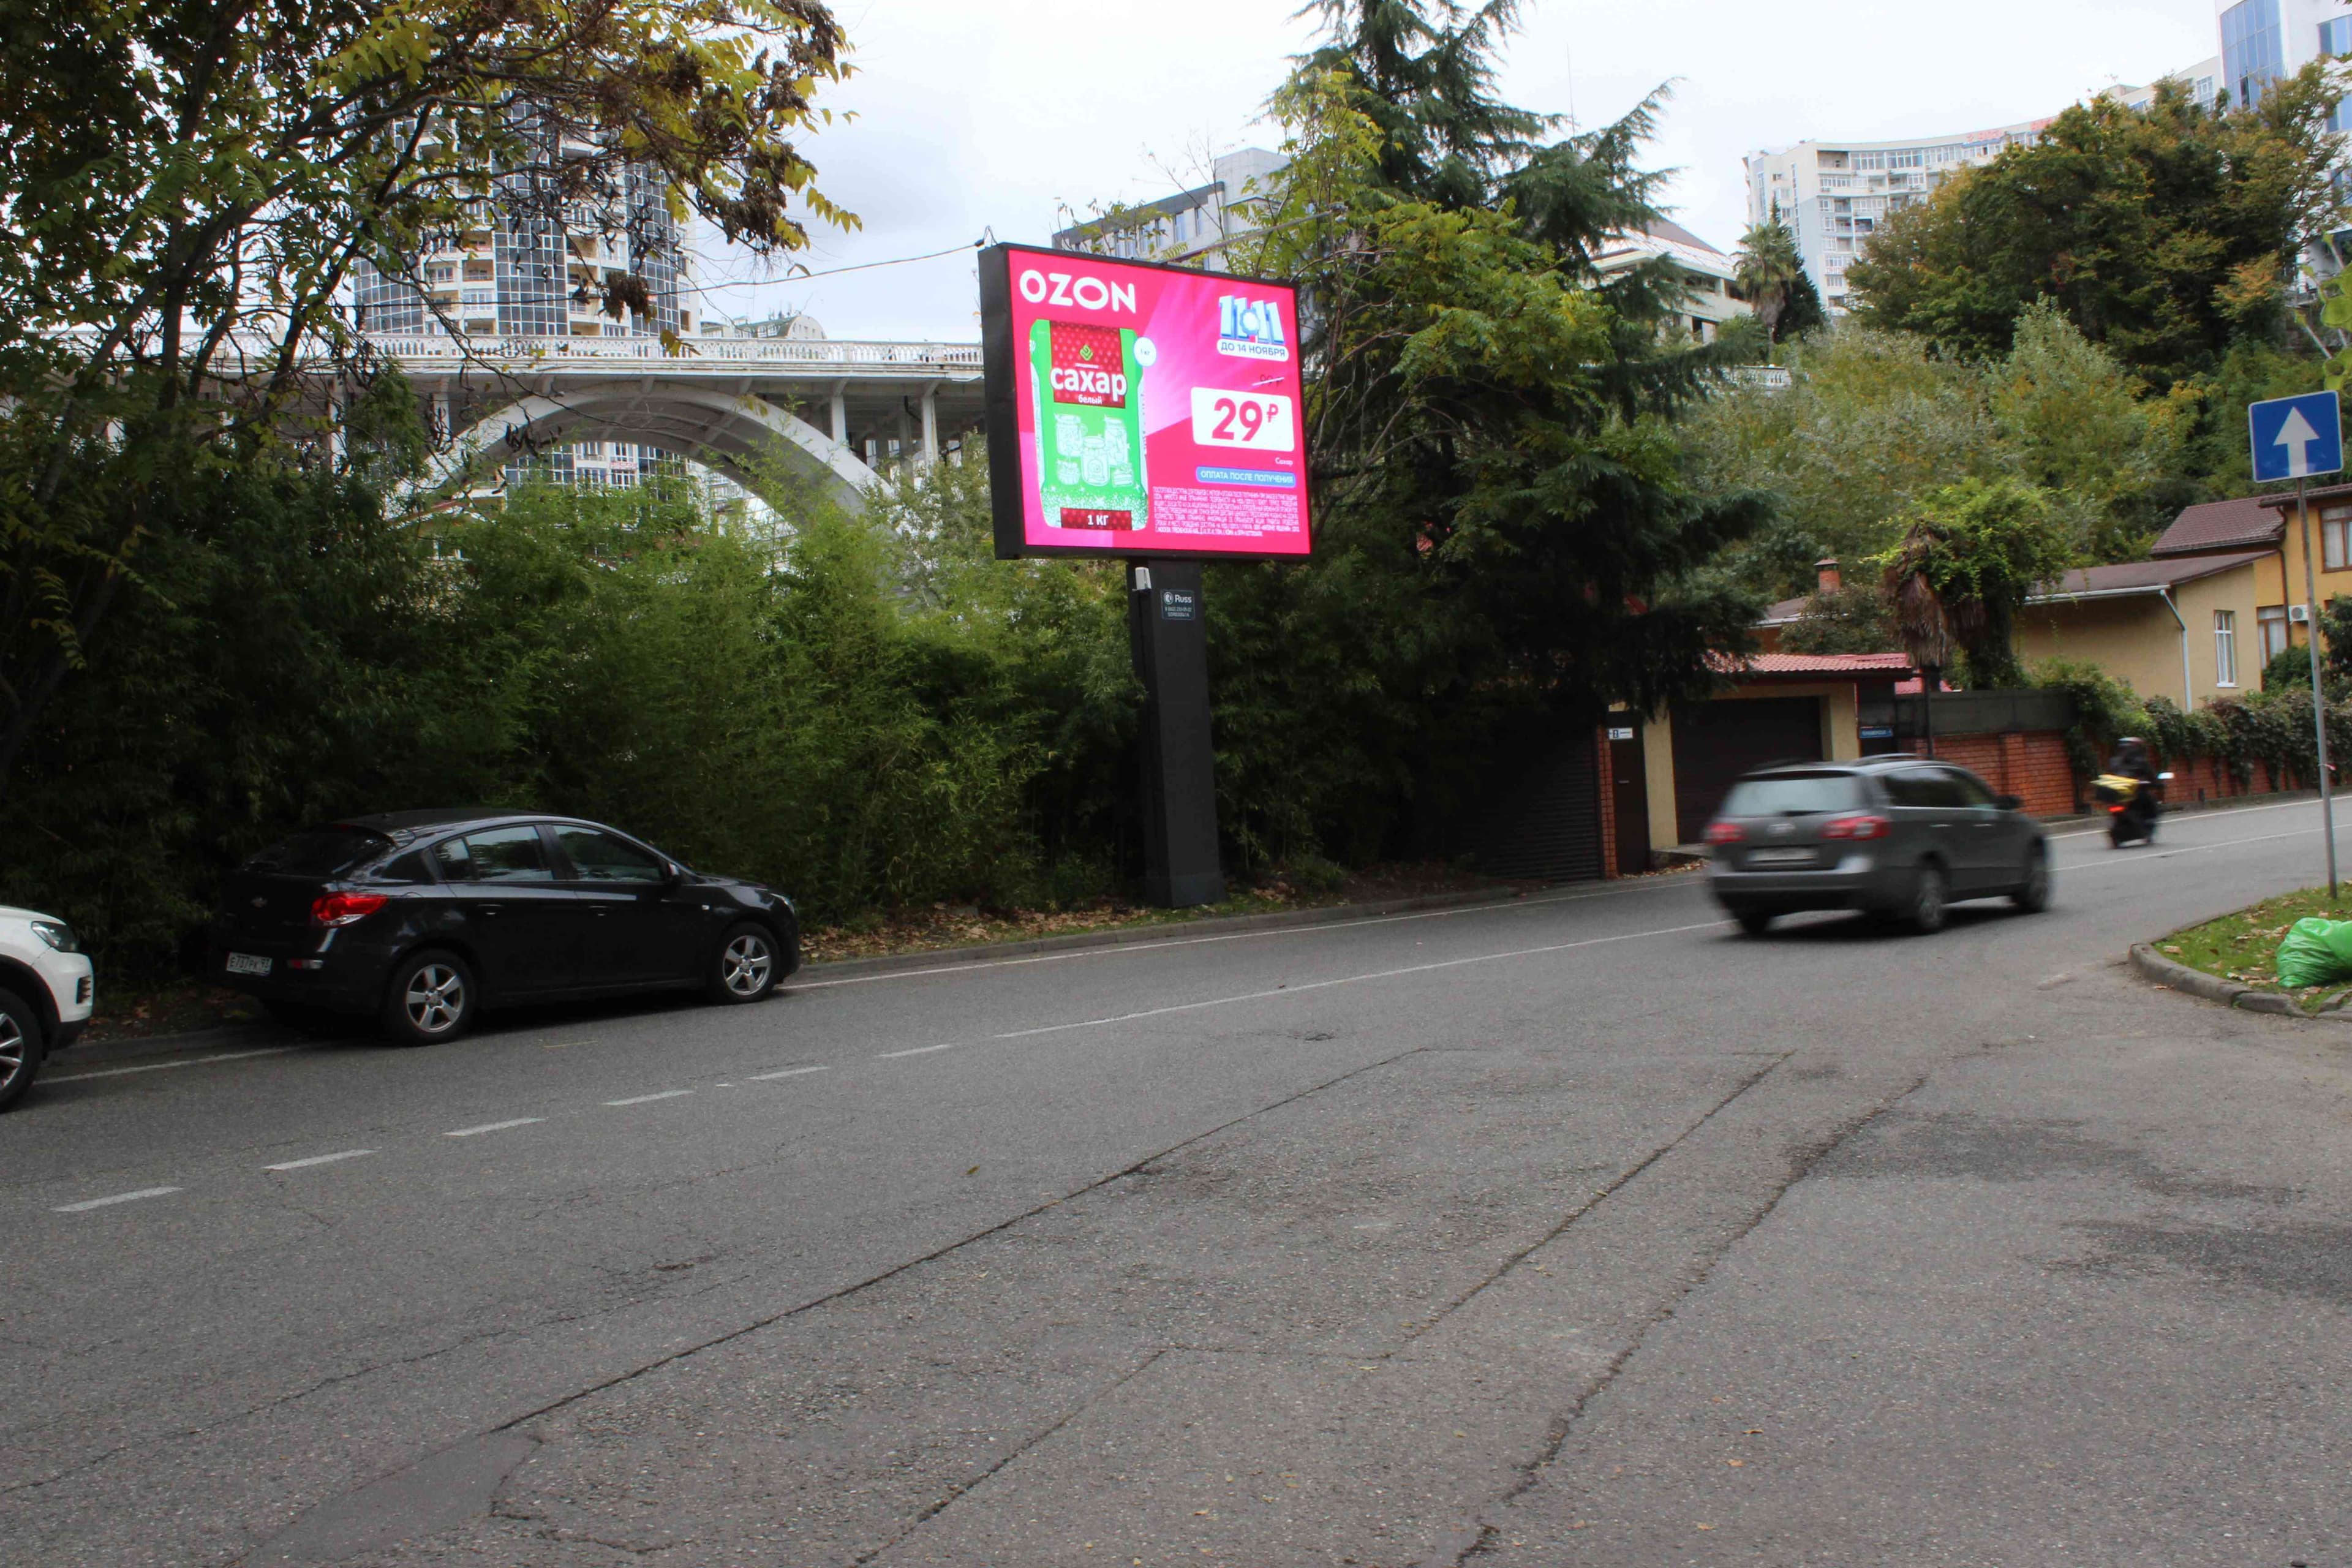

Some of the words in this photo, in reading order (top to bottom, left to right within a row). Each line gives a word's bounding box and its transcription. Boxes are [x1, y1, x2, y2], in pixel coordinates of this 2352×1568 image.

[1019, 270, 1136, 314] OZON
[1221, 342, 1235, 352] ДО
[1237, 344, 1247, 353] 14
[1250, 345, 1286, 357] НОЯБРЯ
[1050, 367, 1127, 402] сахар
[1078, 394, 1102, 405] белый
[1200, 470, 1228, 480] ОПЛАТА
[1230, 472, 1253, 481] ПОСЛЕ
[1254, 473, 1294, 484] ПОЛУЧЕНИЯ
[1087, 514, 1094, 525] 1
[1096, 514, 1109, 526] КГ
[1174, 594, 1192, 603] Russ
